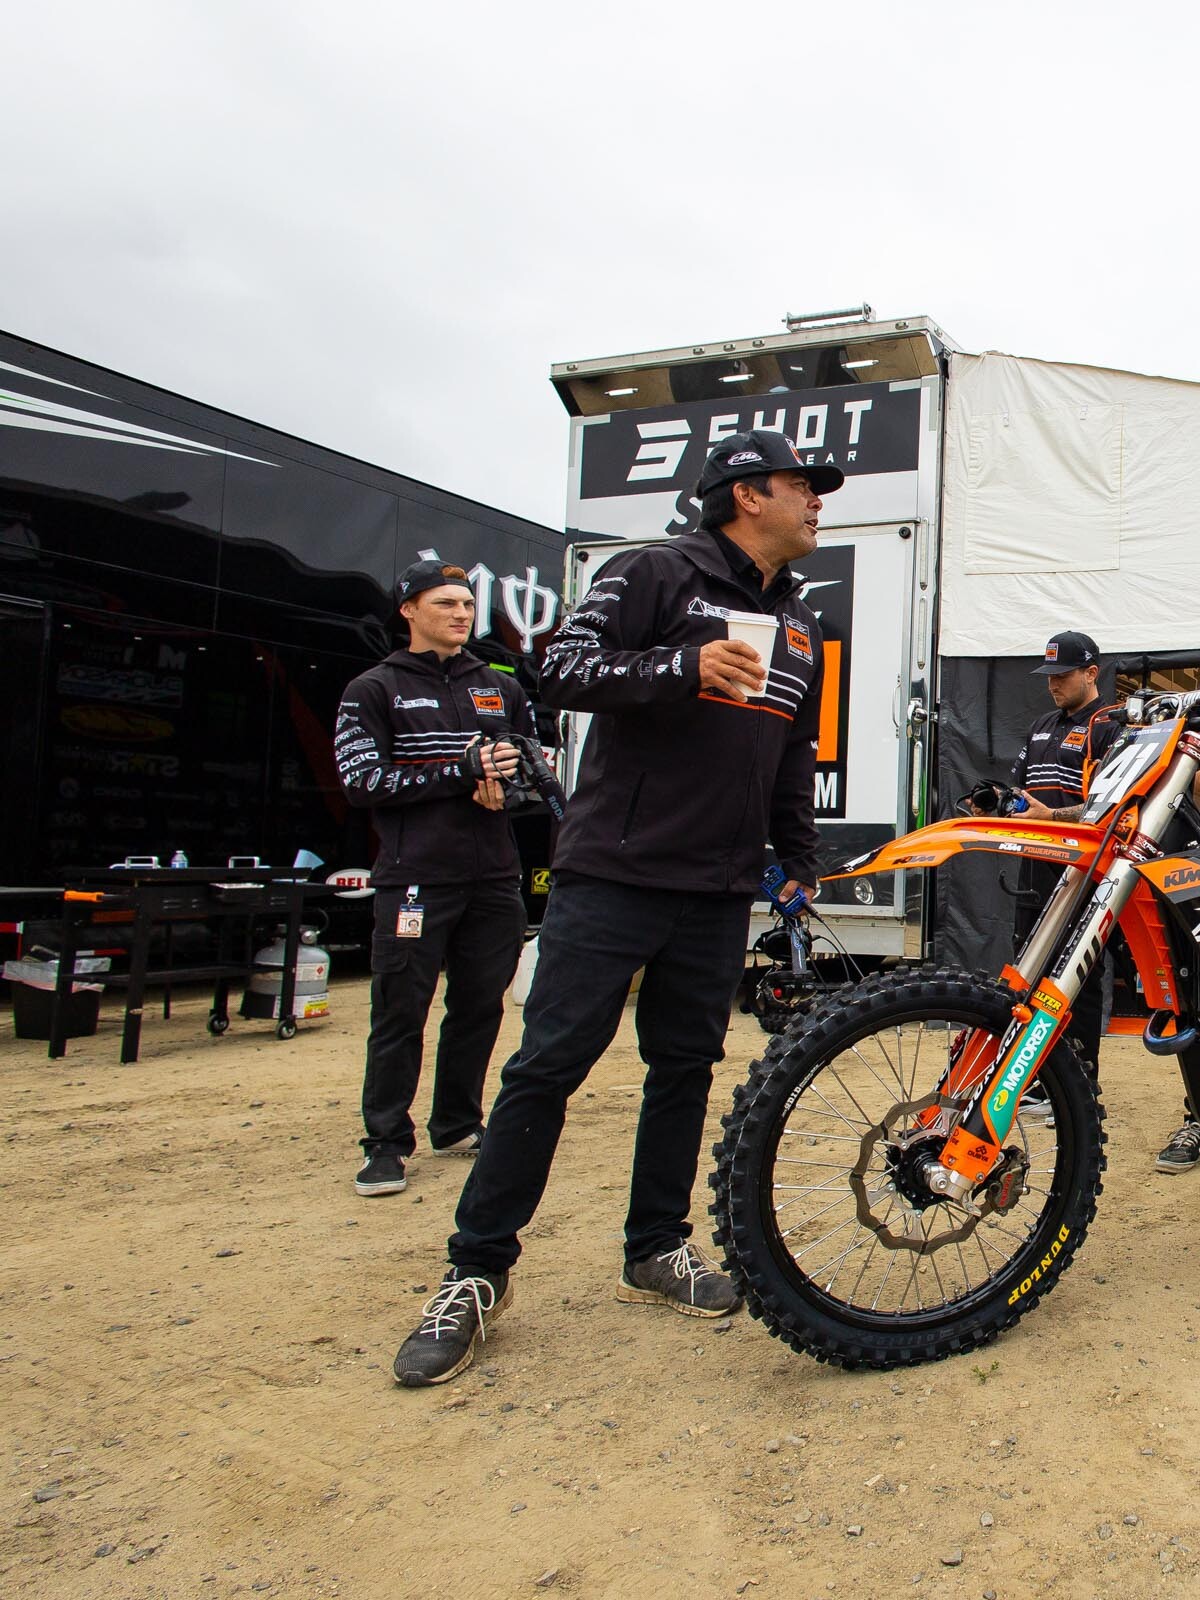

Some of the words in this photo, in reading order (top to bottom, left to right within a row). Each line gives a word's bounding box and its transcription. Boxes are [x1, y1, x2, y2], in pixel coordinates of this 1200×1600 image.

[805, 449, 858, 467] EAR
[338, 750, 380, 773] OGIO
[1088, 742, 1161, 804] 41
[892, 854, 936, 866] KTM
[998, 842, 1022, 853] KTM
[1023, 845, 1071, 860] POWERPARTS
[1007, 1017, 1053, 1092] MOTOREX
[1007, 1223, 1071, 1306] DUNLOP
